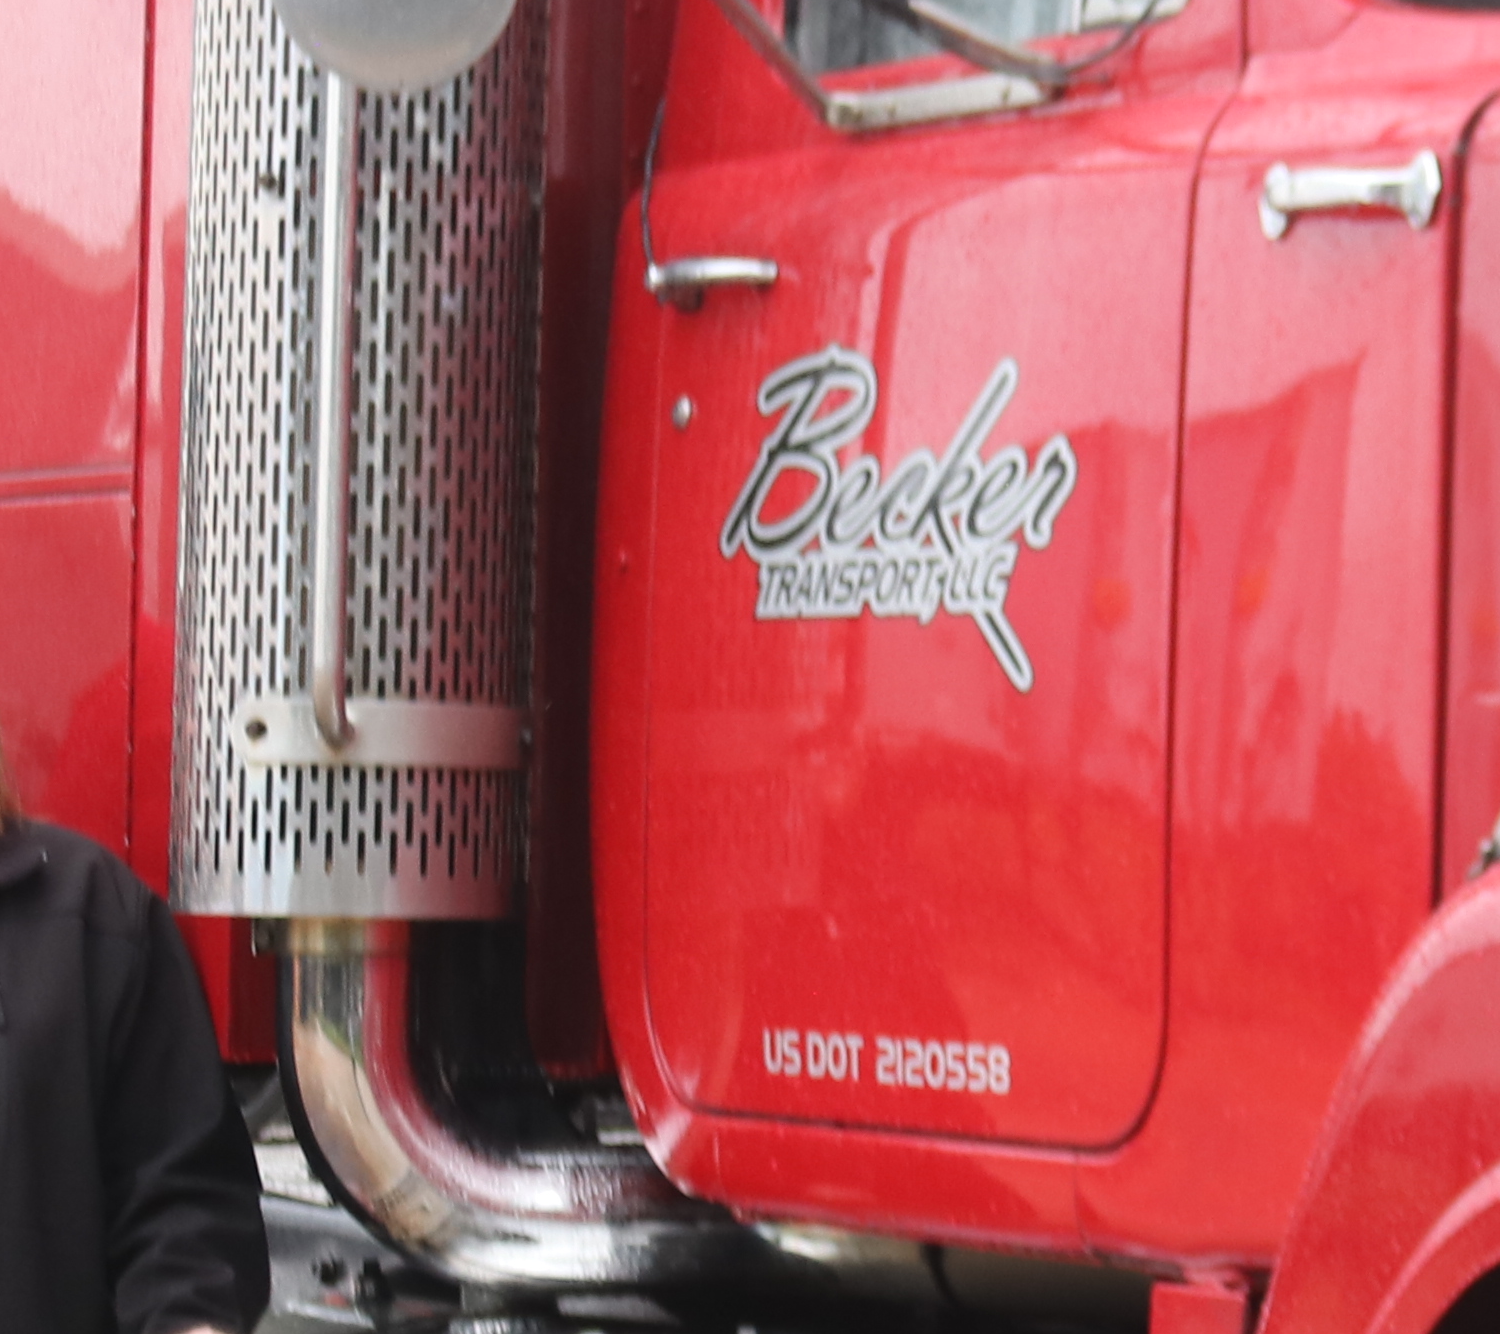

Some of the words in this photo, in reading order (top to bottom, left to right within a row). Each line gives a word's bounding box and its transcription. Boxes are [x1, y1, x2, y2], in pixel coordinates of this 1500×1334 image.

[719, 342, 1077, 693] Becker
[762, 1027, 801, 1077] US
[806, 1030, 864, 1082] DOT
[875, 1034, 1011, 1096] 2120558
